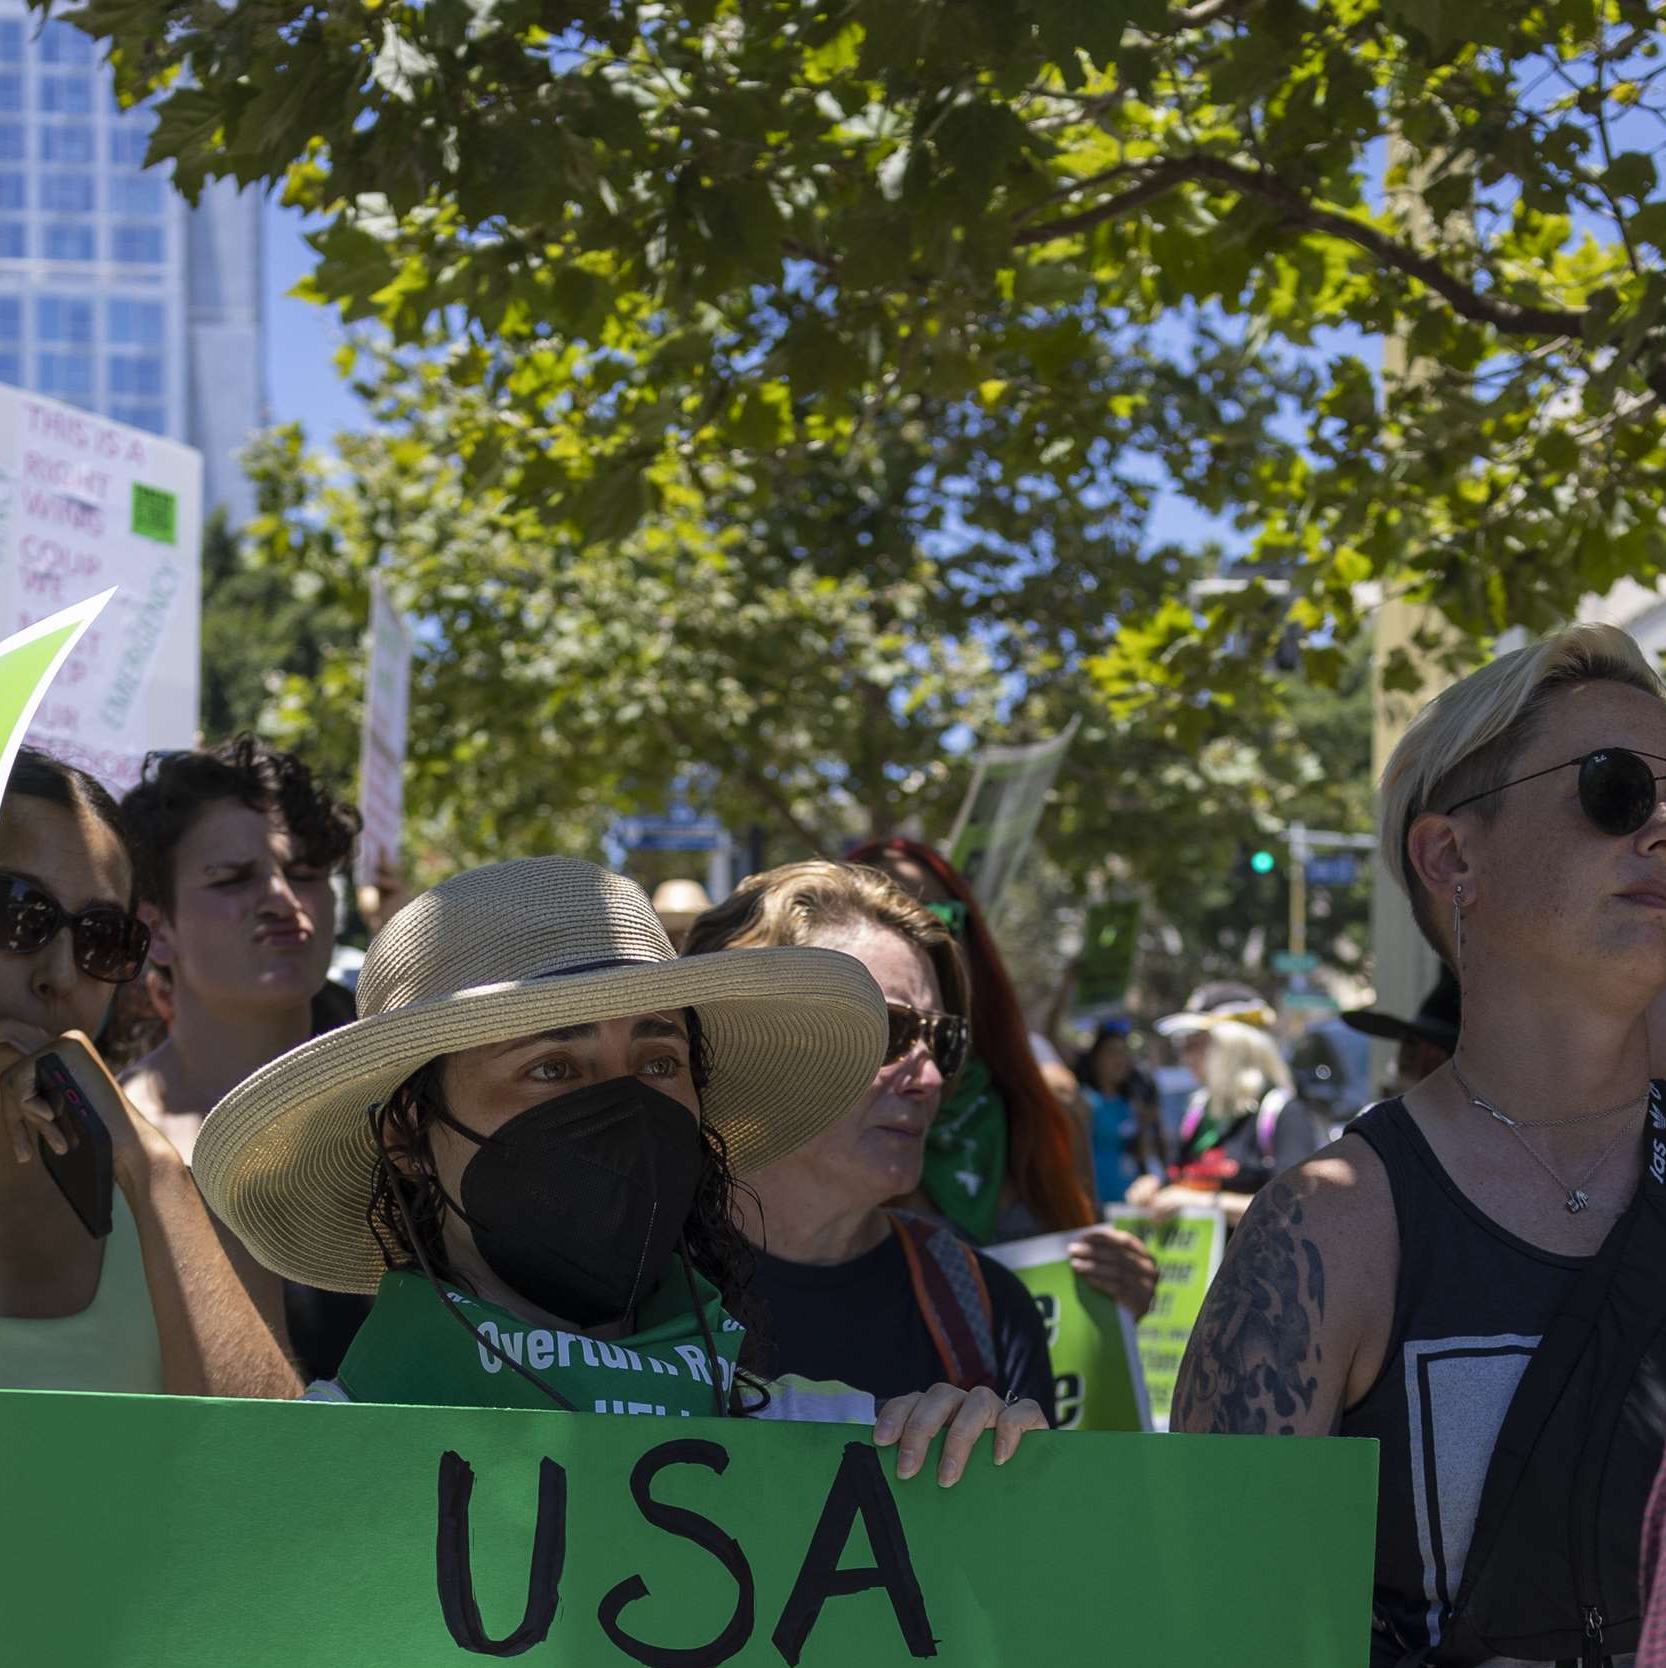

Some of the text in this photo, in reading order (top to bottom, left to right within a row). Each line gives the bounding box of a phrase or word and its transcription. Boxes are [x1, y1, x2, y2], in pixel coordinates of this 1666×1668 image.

[25, 402, 145, 466] THIS IS A
